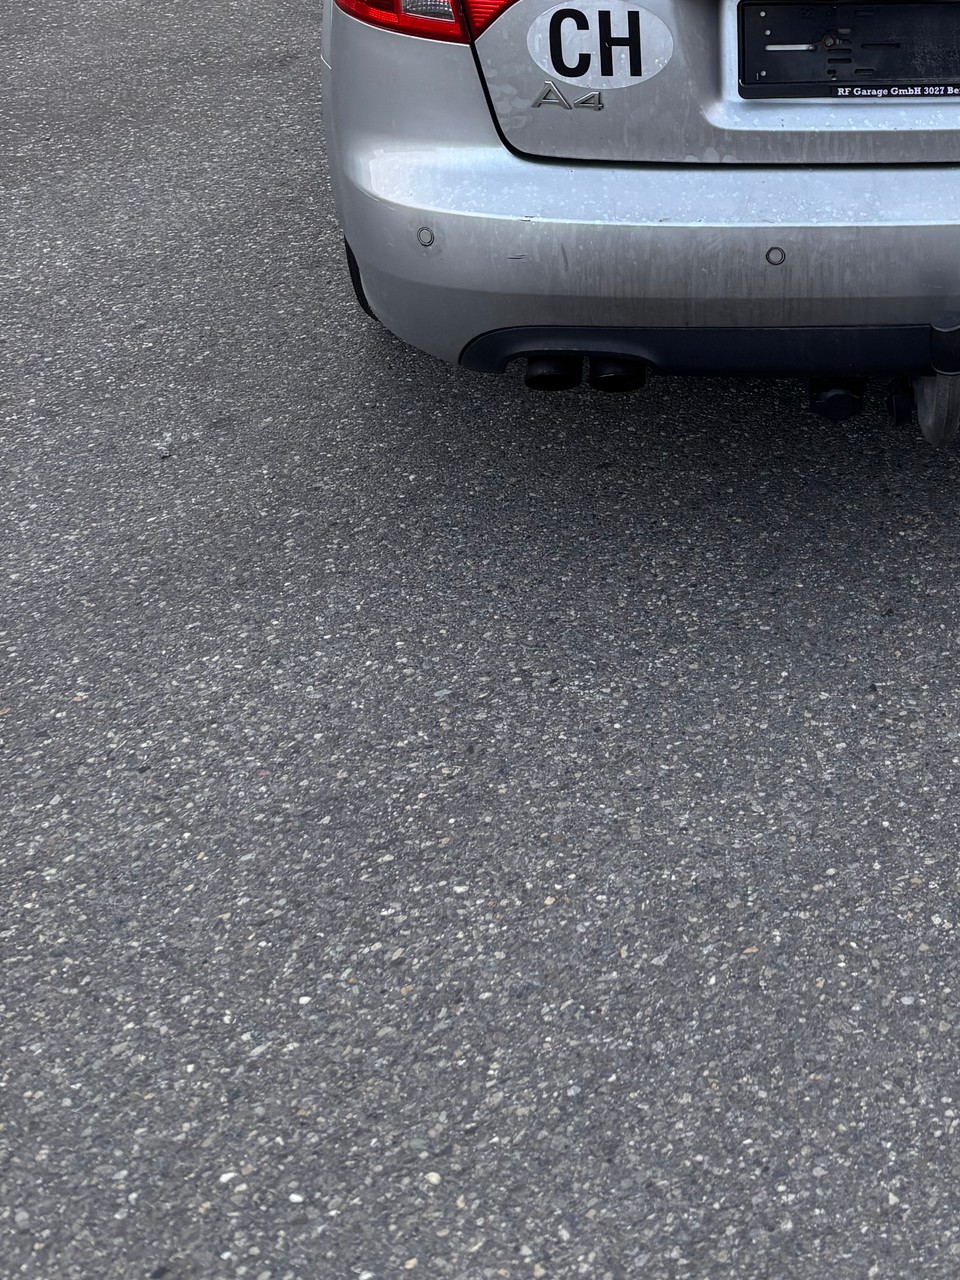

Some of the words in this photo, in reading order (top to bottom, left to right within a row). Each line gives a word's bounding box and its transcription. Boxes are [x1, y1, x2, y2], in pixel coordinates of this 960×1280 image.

[549, 8, 642, 78] CH
[531, 80, 604, 111] A4
[837, 87, 852, 96] RF
[853, 87, 889, 98] Garage
[890, 86, 922, 95] GmbH
[923, 86, 945, 95] 3027
